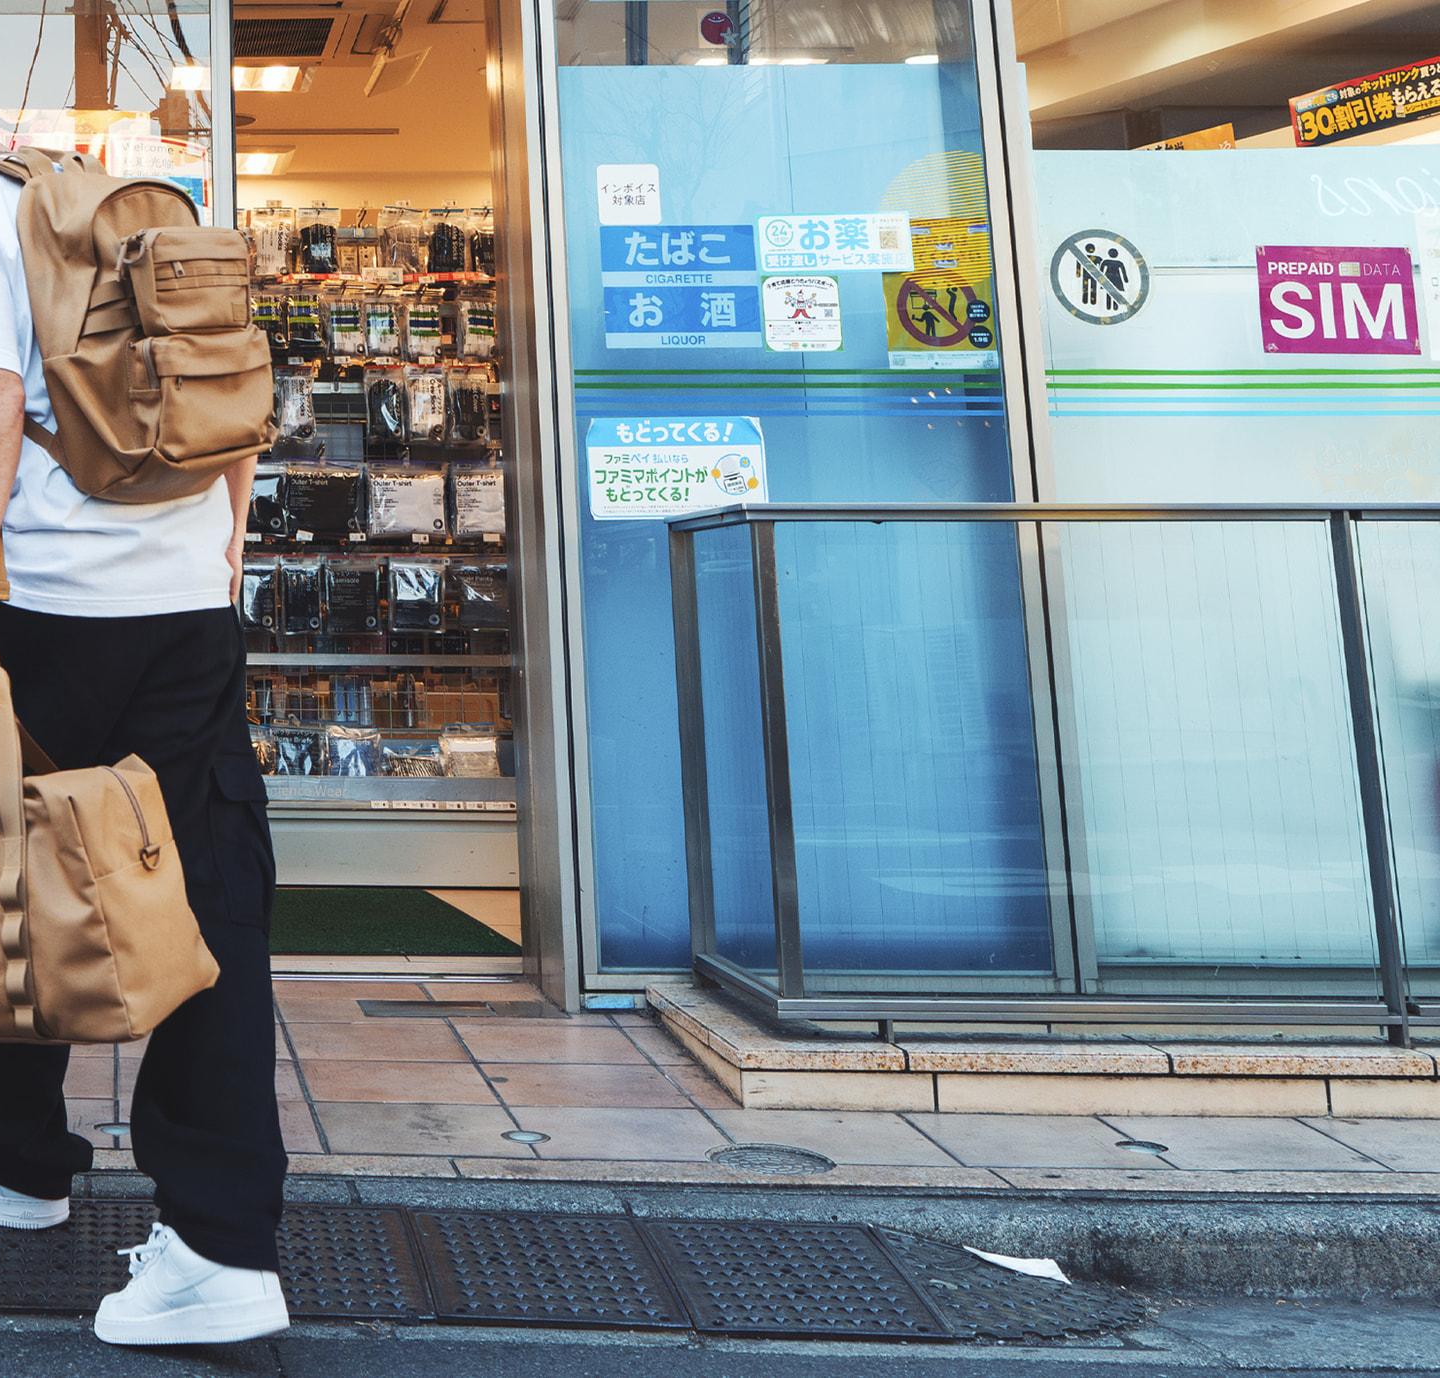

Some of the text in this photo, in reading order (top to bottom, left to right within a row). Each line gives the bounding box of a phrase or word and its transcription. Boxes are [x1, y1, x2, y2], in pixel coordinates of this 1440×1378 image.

[601, 183, 657, 194] インボイス
[612, 195, 646, 206] 対象店
[771, 225, 788, 237] 24
[798, 217, 869, 250] お薬
[624, 231, 731, 266] たばこ
[767, 254, 816, 267] 受け渡し
[818, 253, 907, 265] サービス実施店
[1267, 262, 1401, 276] PREPAID DATA
[645, 274, 713, 283] CIGARETTE
[1269, 281, 1408, 339] SIM
[661, 335, 706, 345] LIQUOR
[616, 420, 733, 443] もどってくる!
[603, 453, 689, 464] ファミペイ 払いなら
[595, 466, 708, 484] ファミマポイントが
[606, 486, 690, 502] もどってくる!
[314, 784, 347, 797] Wear
